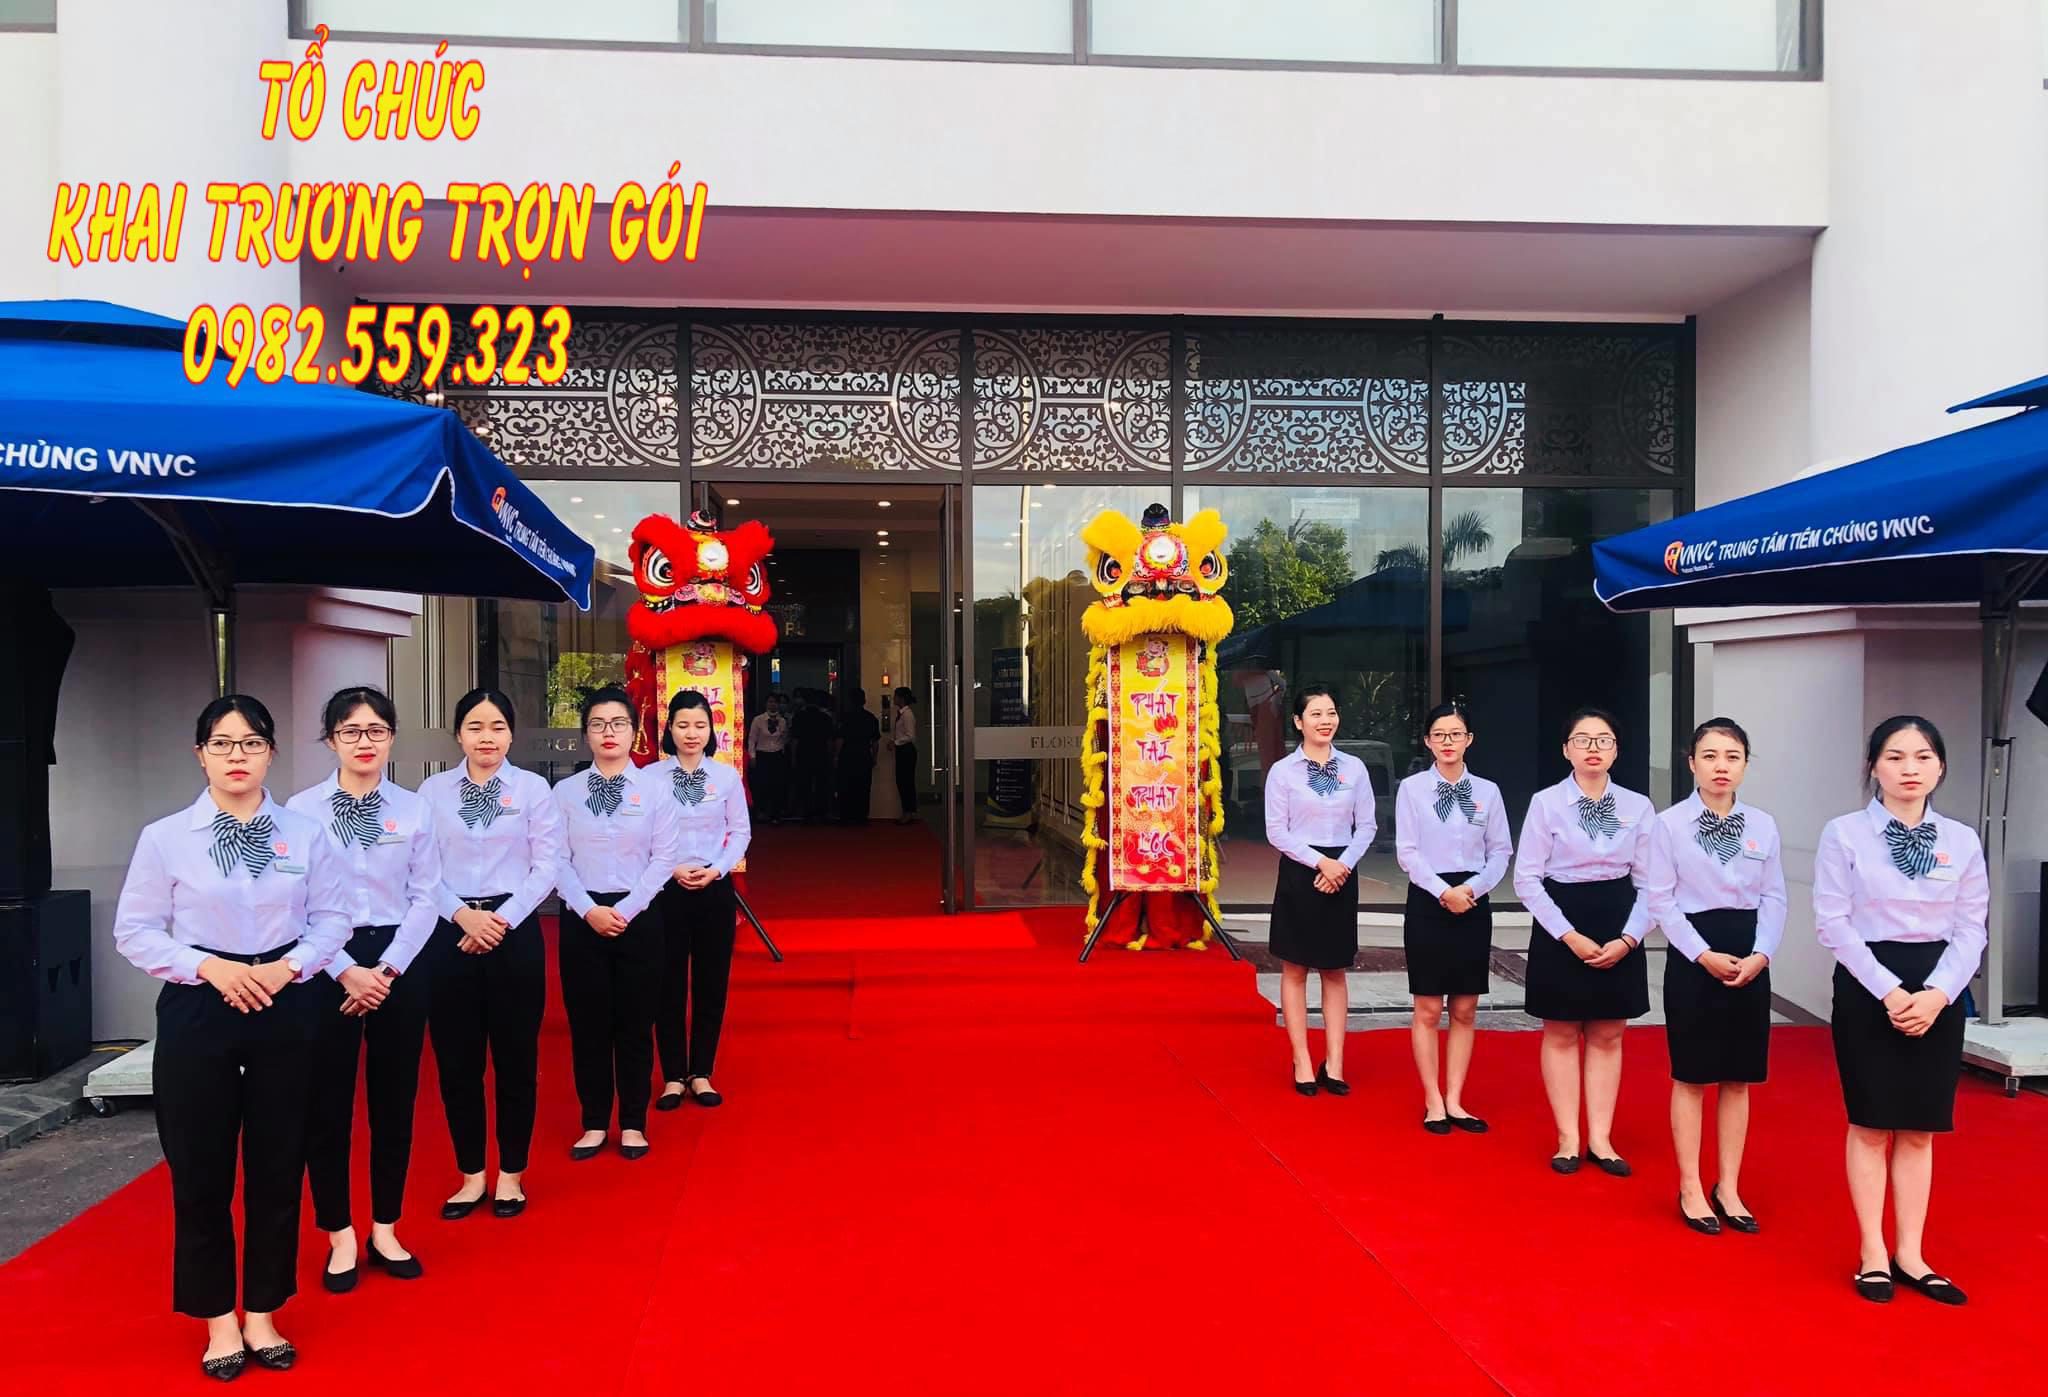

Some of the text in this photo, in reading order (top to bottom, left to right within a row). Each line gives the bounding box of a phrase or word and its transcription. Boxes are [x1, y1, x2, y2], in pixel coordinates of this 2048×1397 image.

[0, 439, 197, 477] HỦNG VNVC
[1679, 540, 1718, 566] VNVC
[1719, 538, 1760, 561] TRUNG
[1882, 515, 1934, 540] VNVC
